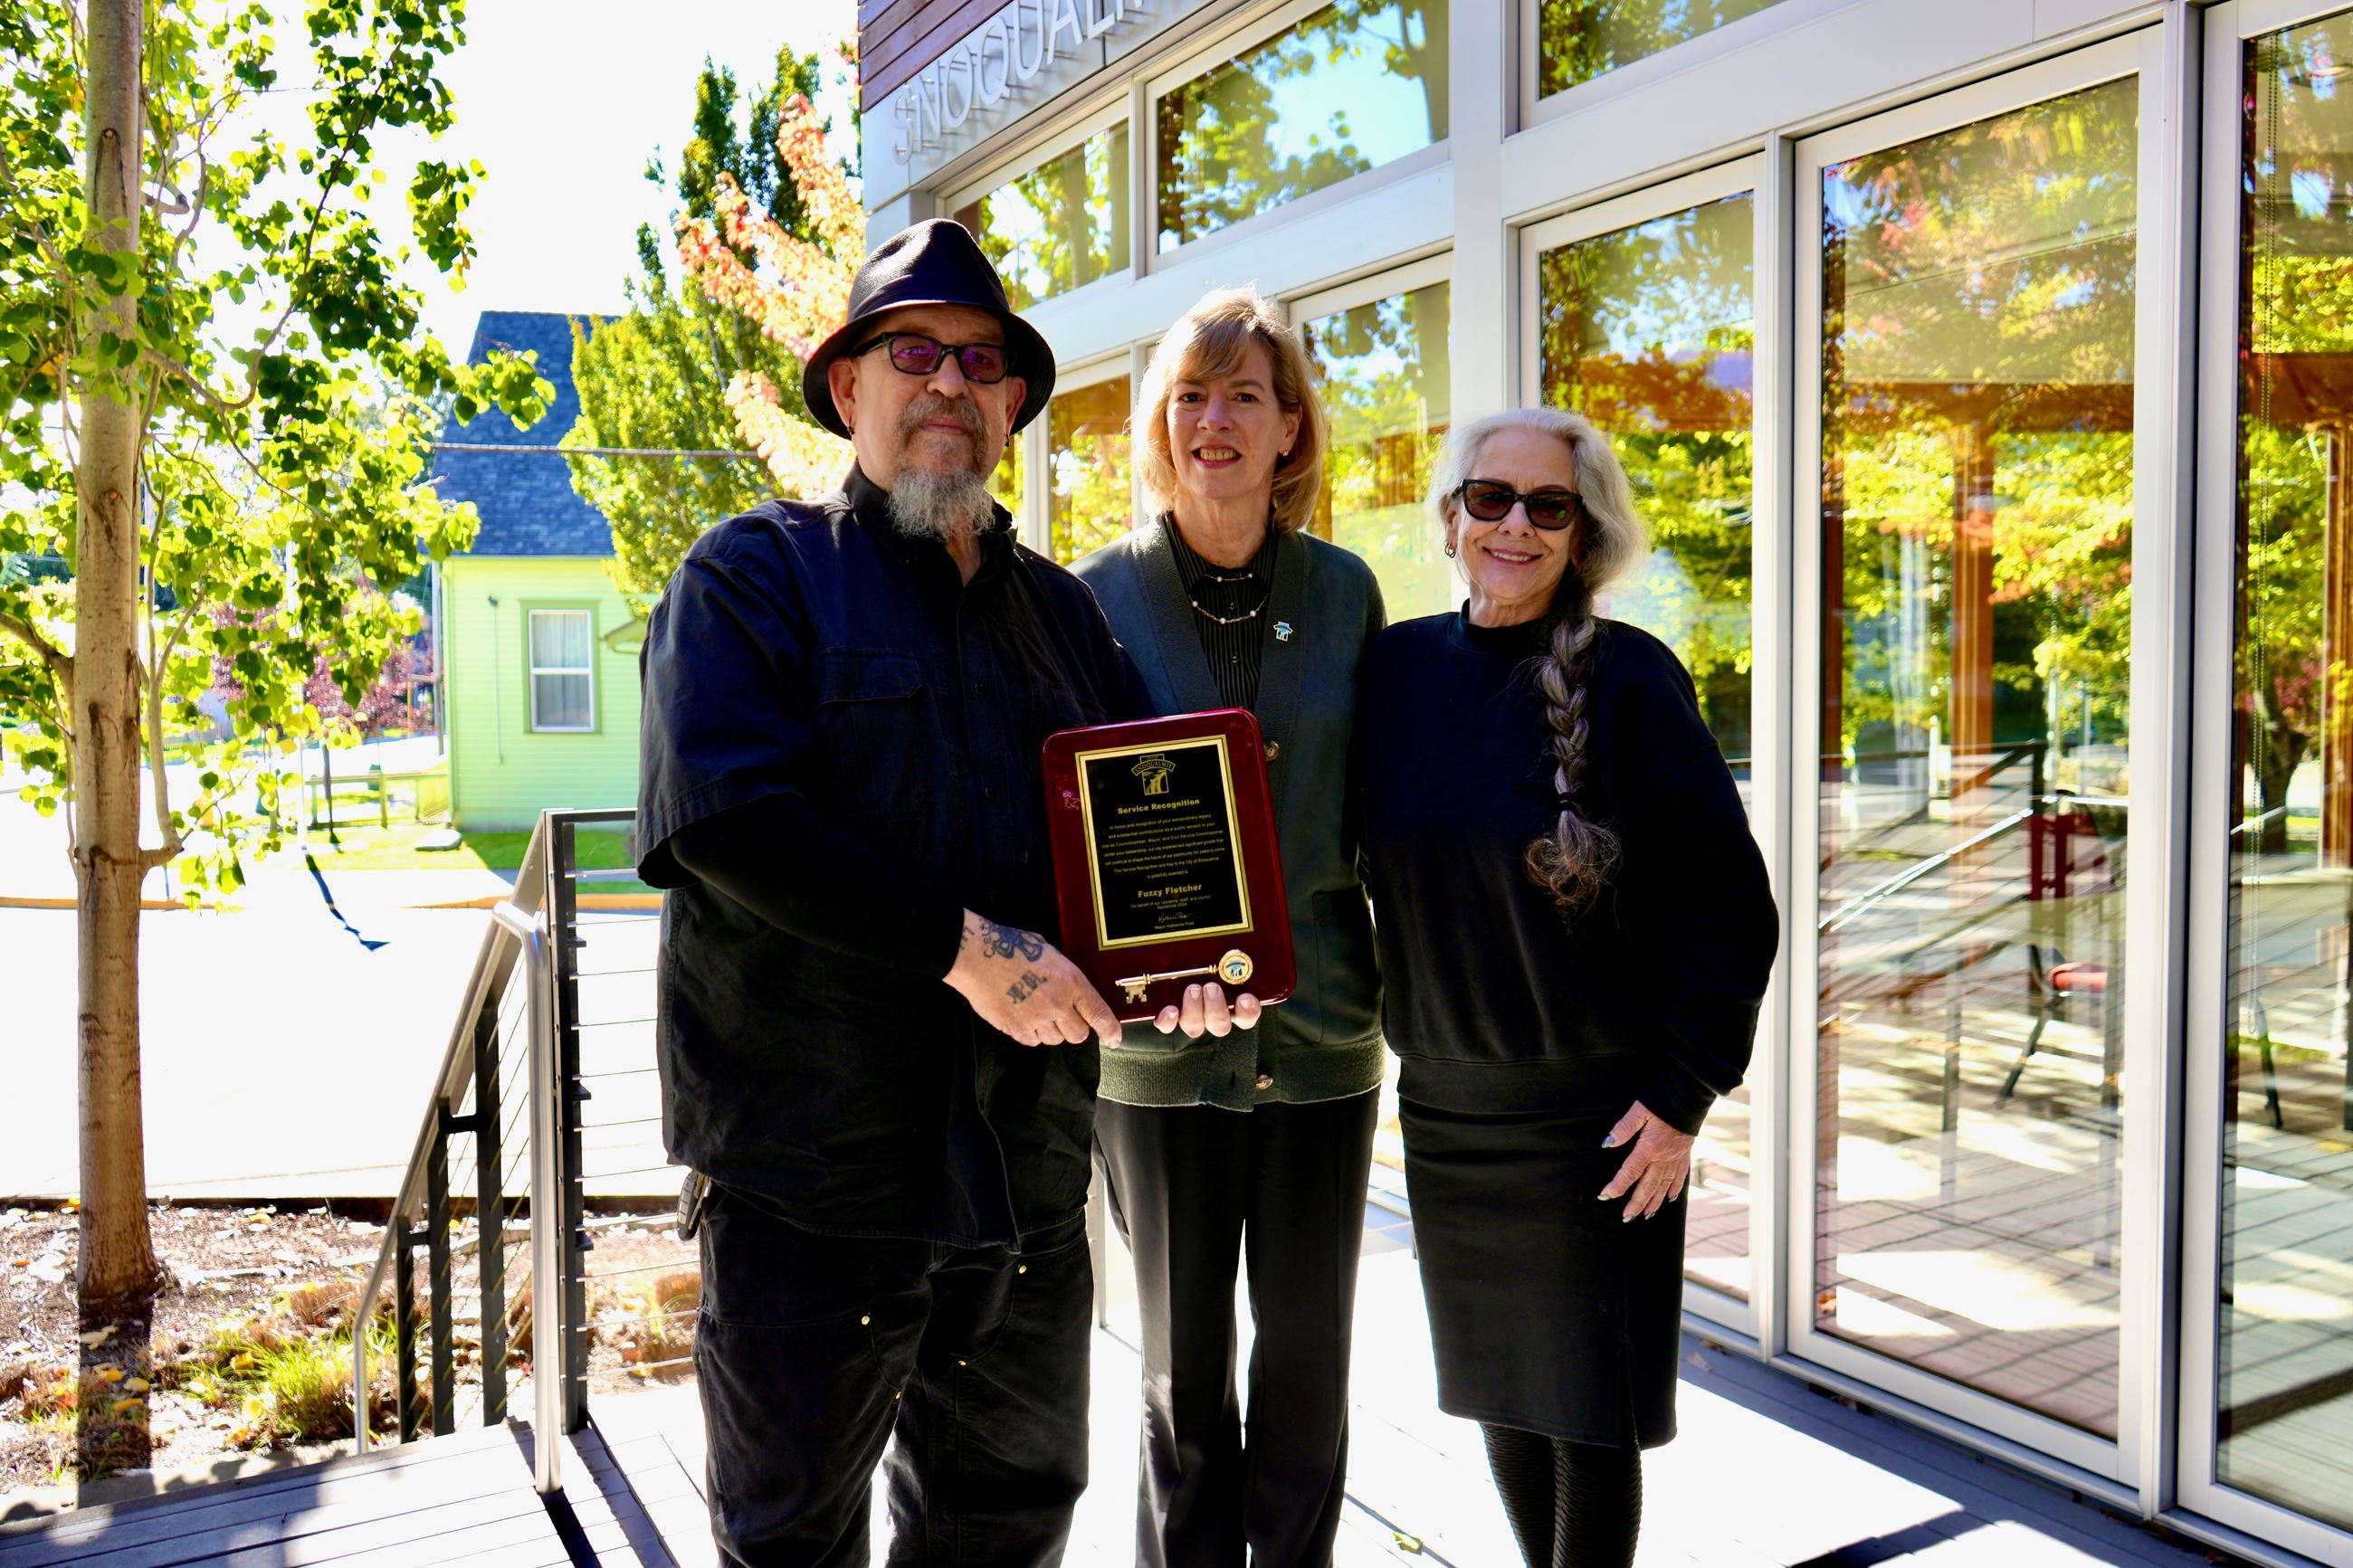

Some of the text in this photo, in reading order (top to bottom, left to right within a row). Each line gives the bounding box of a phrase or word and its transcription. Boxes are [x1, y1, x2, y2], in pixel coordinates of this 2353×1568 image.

[892, 0, 1143, 166] SNOQUAL
[1117, 799, 1200, 813] Service Recognition
[1138, 884, 1202, 898] Fuzzy Fletcher
